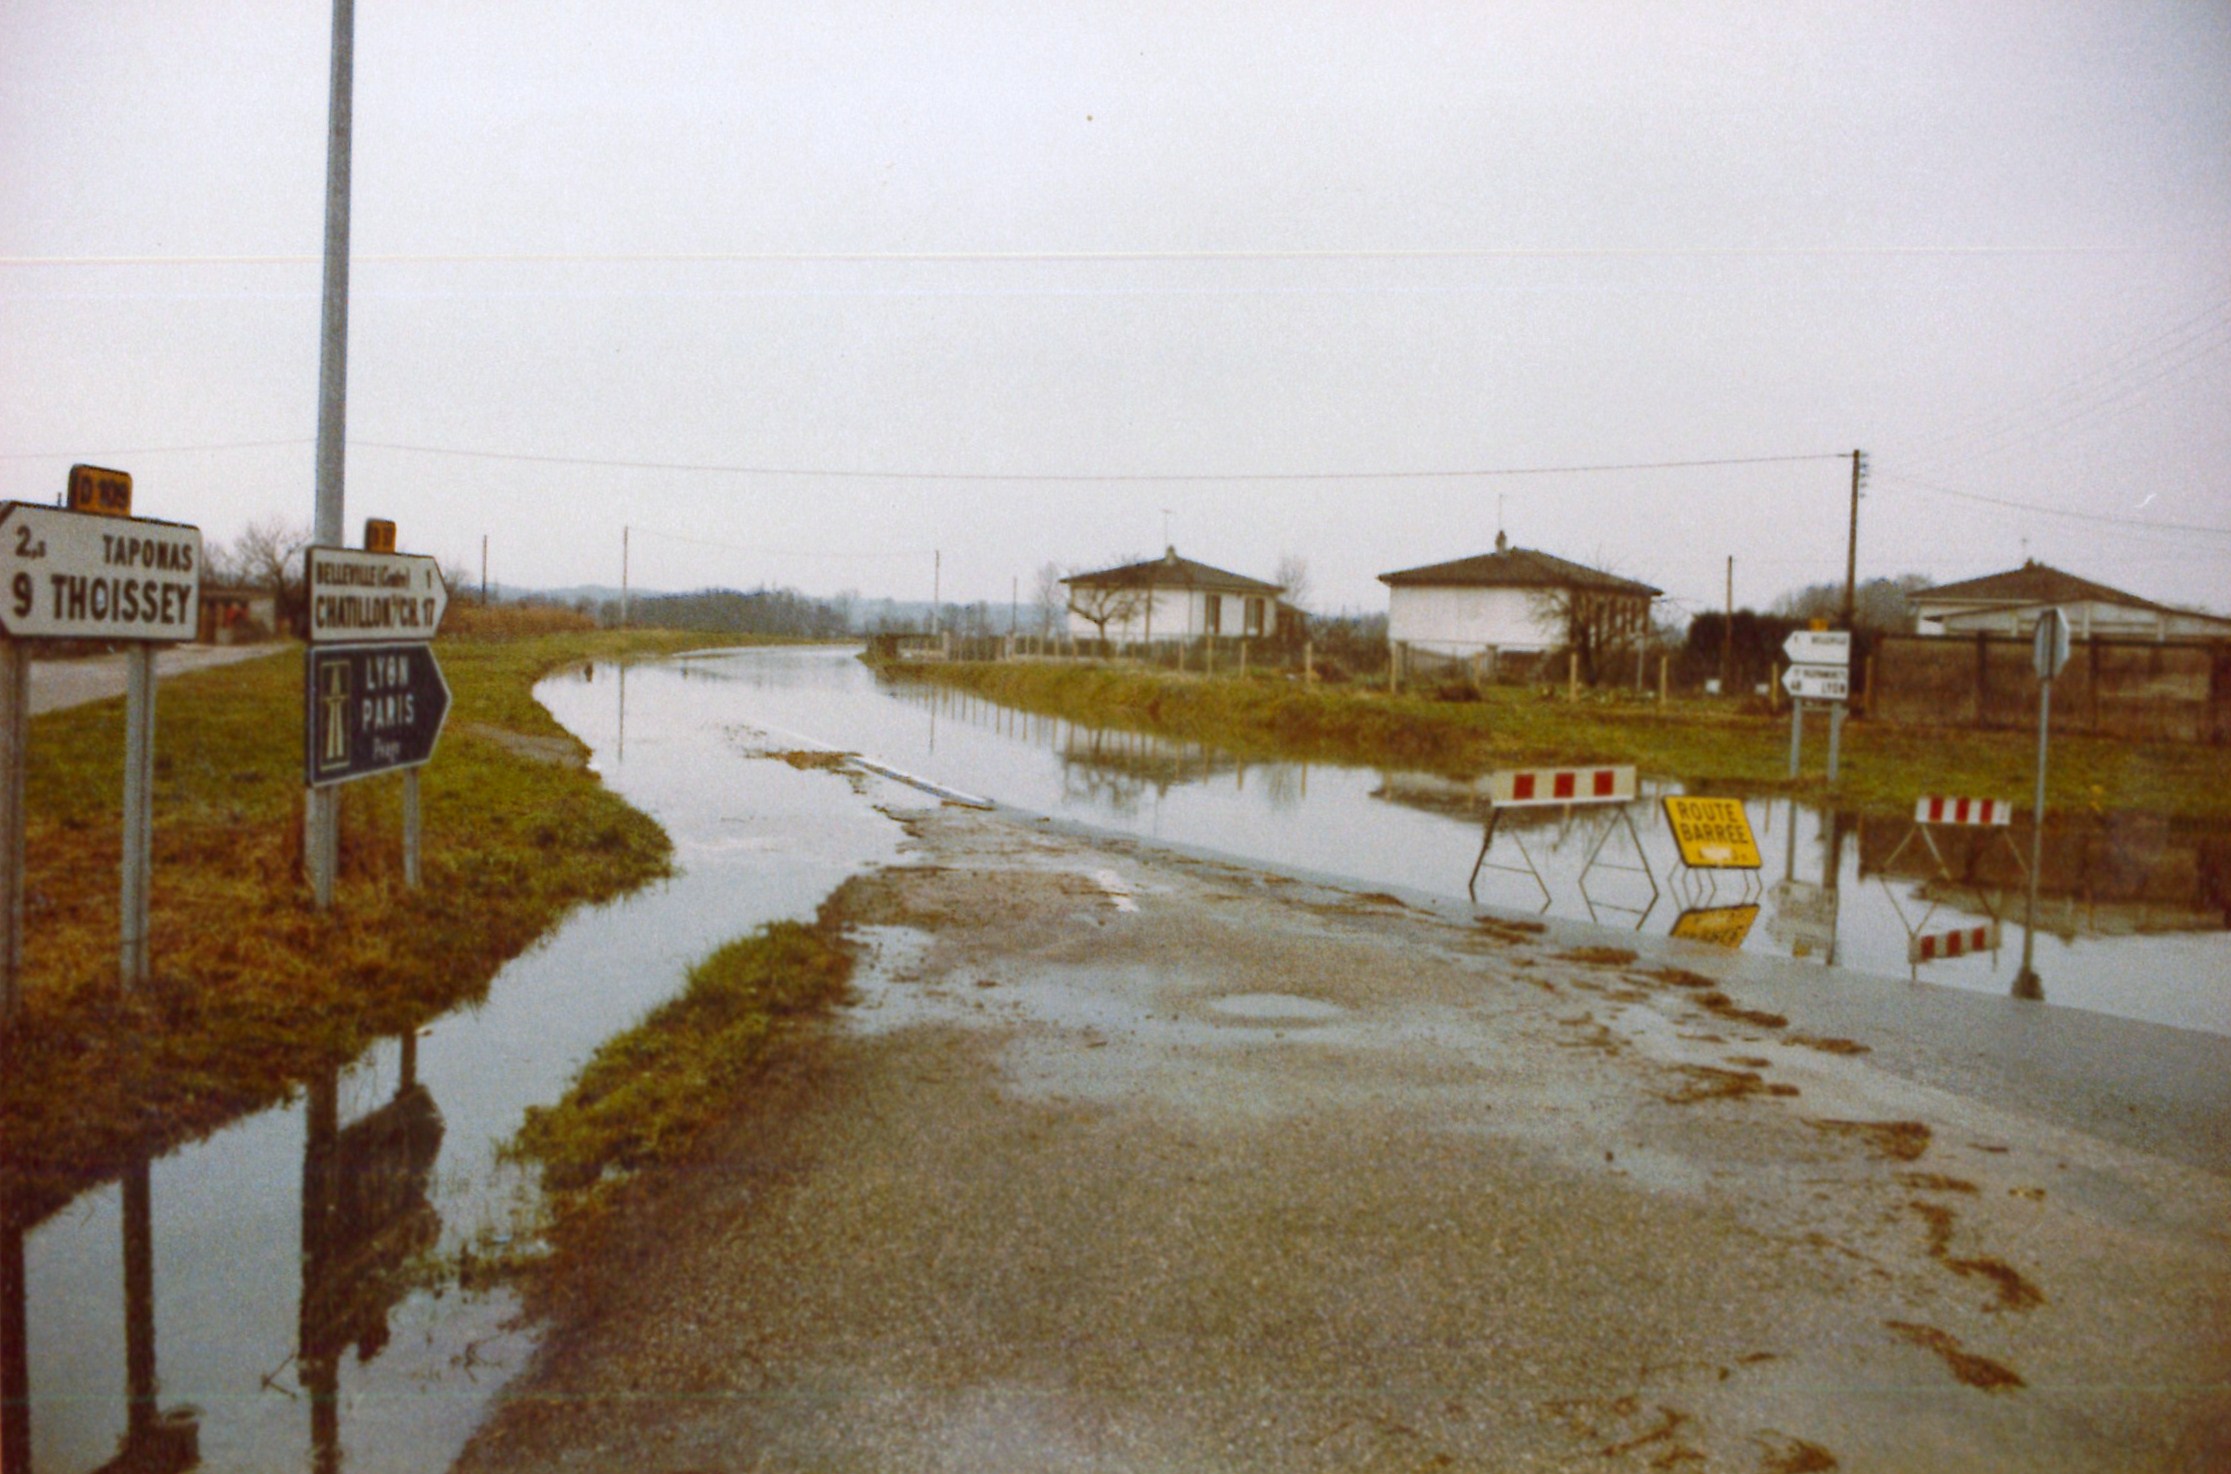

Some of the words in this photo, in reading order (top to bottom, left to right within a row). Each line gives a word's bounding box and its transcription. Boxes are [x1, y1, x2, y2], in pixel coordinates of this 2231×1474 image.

[102, 534, 192, 572] TAPONAS
[316, 561, 375, 587] BELLEVILLE
[13, 571, 32, 618] 9
[51, 573, 192, 624] THOISSEY
[423, 598, 436, 627] 17
[365, 655, 409, 690] LYON
[361, 693, 414, 732] PARIS
[1677, 801, 1738, 823] ROUTE
